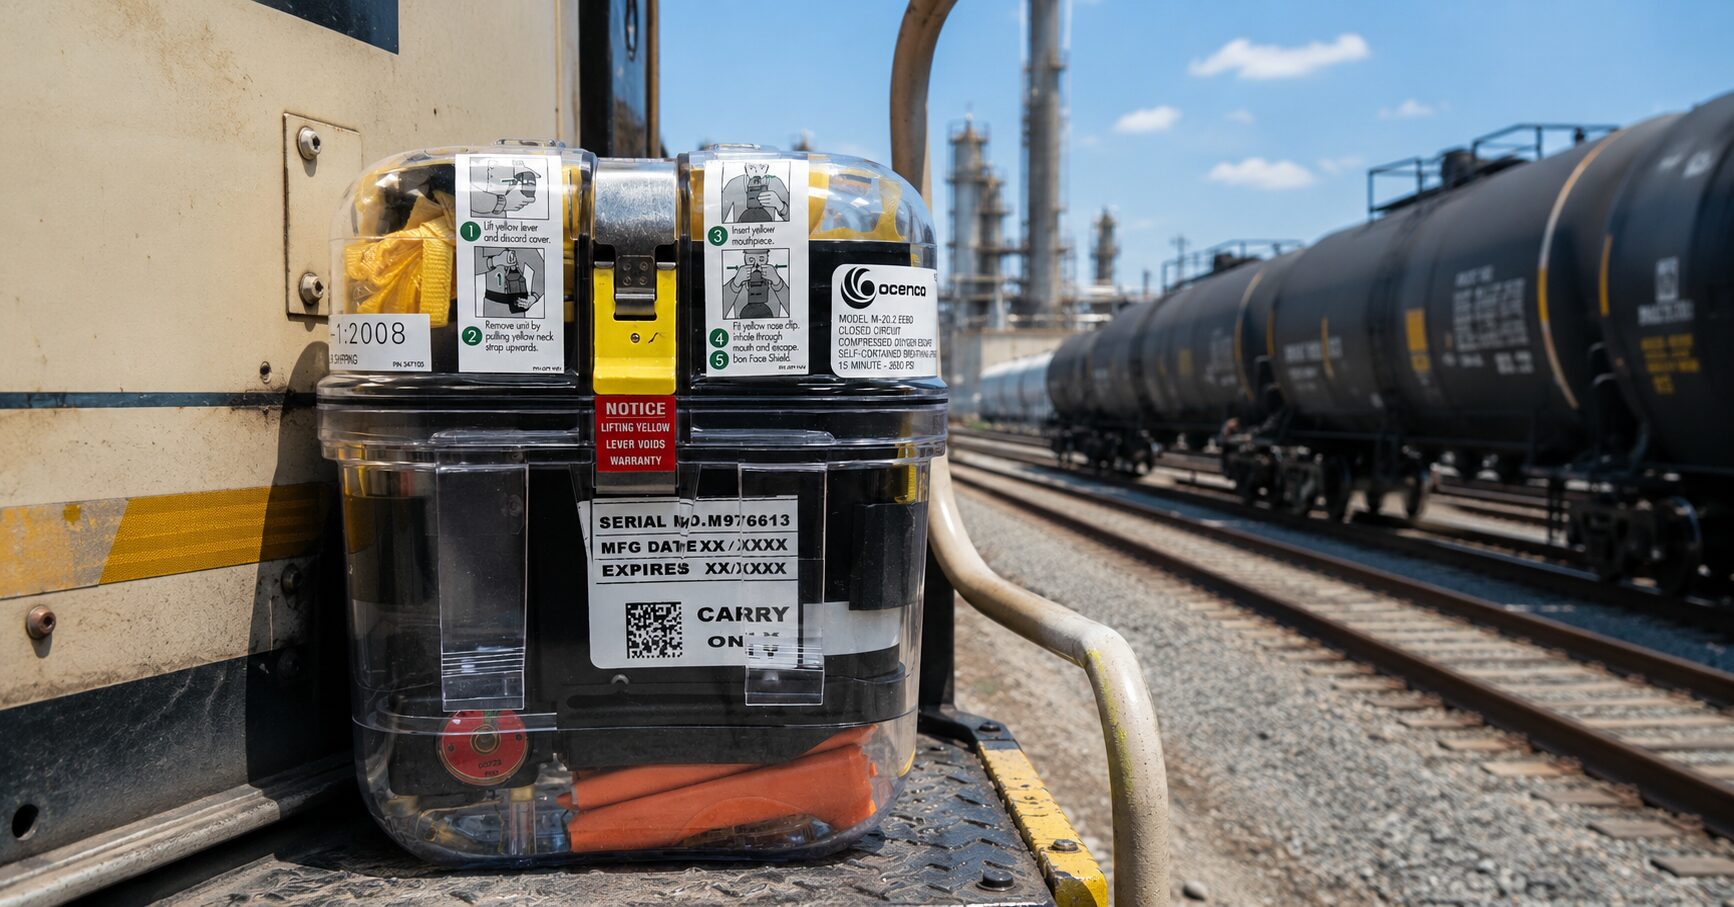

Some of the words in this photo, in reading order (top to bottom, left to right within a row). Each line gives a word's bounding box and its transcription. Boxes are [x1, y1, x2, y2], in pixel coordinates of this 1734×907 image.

[495, 220, 518, 235] yellow
[520, 221, 538, 232] lever
[732, 226, 750, 235] Insert
[752, 224, 775, 236] yellow
[484, 232, 499, 242] and
[500, 233, 527, 243] discard
[529, 236, 551, 244] cover.
[713, 229, 722, 243] 3
[732, 236, 775, 247] mouthpiece.
[839, 314, 868, 324] MODEL
[485, 320, 514, 330] Remove
[516, 321, 529, 330] unit
[531, 320, 541, 332] by
[733, 321, 741, 331] Fit
[743, 321, 765, 332] yellow
[838, 326, 871, 335] CLOSED
[873, 326, 901, 335] CIRCUIT
[468, 330, 476, 343] 2
[485, 331, 509, 343] pulling
[512, 331, 535, 342] yellow
[536, 331, 554, 341] neck
[715, 332, 723, 346] 4
[733, 332, 754, 341] inhale
[756, 331, 783, 343] through
[838, 337, 892, 347] COMPRESSED
[485, 343, 504, 354] strap
[506, 343, 539, 354] upwards.
[733, 343, 754, 352] mouth
[756, 343, 770, 352] and
[771, 344, 799, 355] escape.
[715, 353, 723, 367] 5
[749, 354, 767, 363] Face
[838, 361, 849, 370] 15
[851, 361, 882, 370] MINUTE
[606, 402, 666, 415] NOTICE
[601, 422, 634, 432] LIFTING
[636, 422, 670, 432] YELLOW
[606, 439, 635, 449] LEVER
[638, 439, 666, 449] VOIDS
[610, 456, 662, 466] WARRANTY
[600, 515, 667, 529] SERIAL
[601, 541, 641, 554] MFG
[648, 540, 697, 553] DATE
[602, 563, 690, 577] EXPIRES
[697, 606, 790, 622] CARRY
